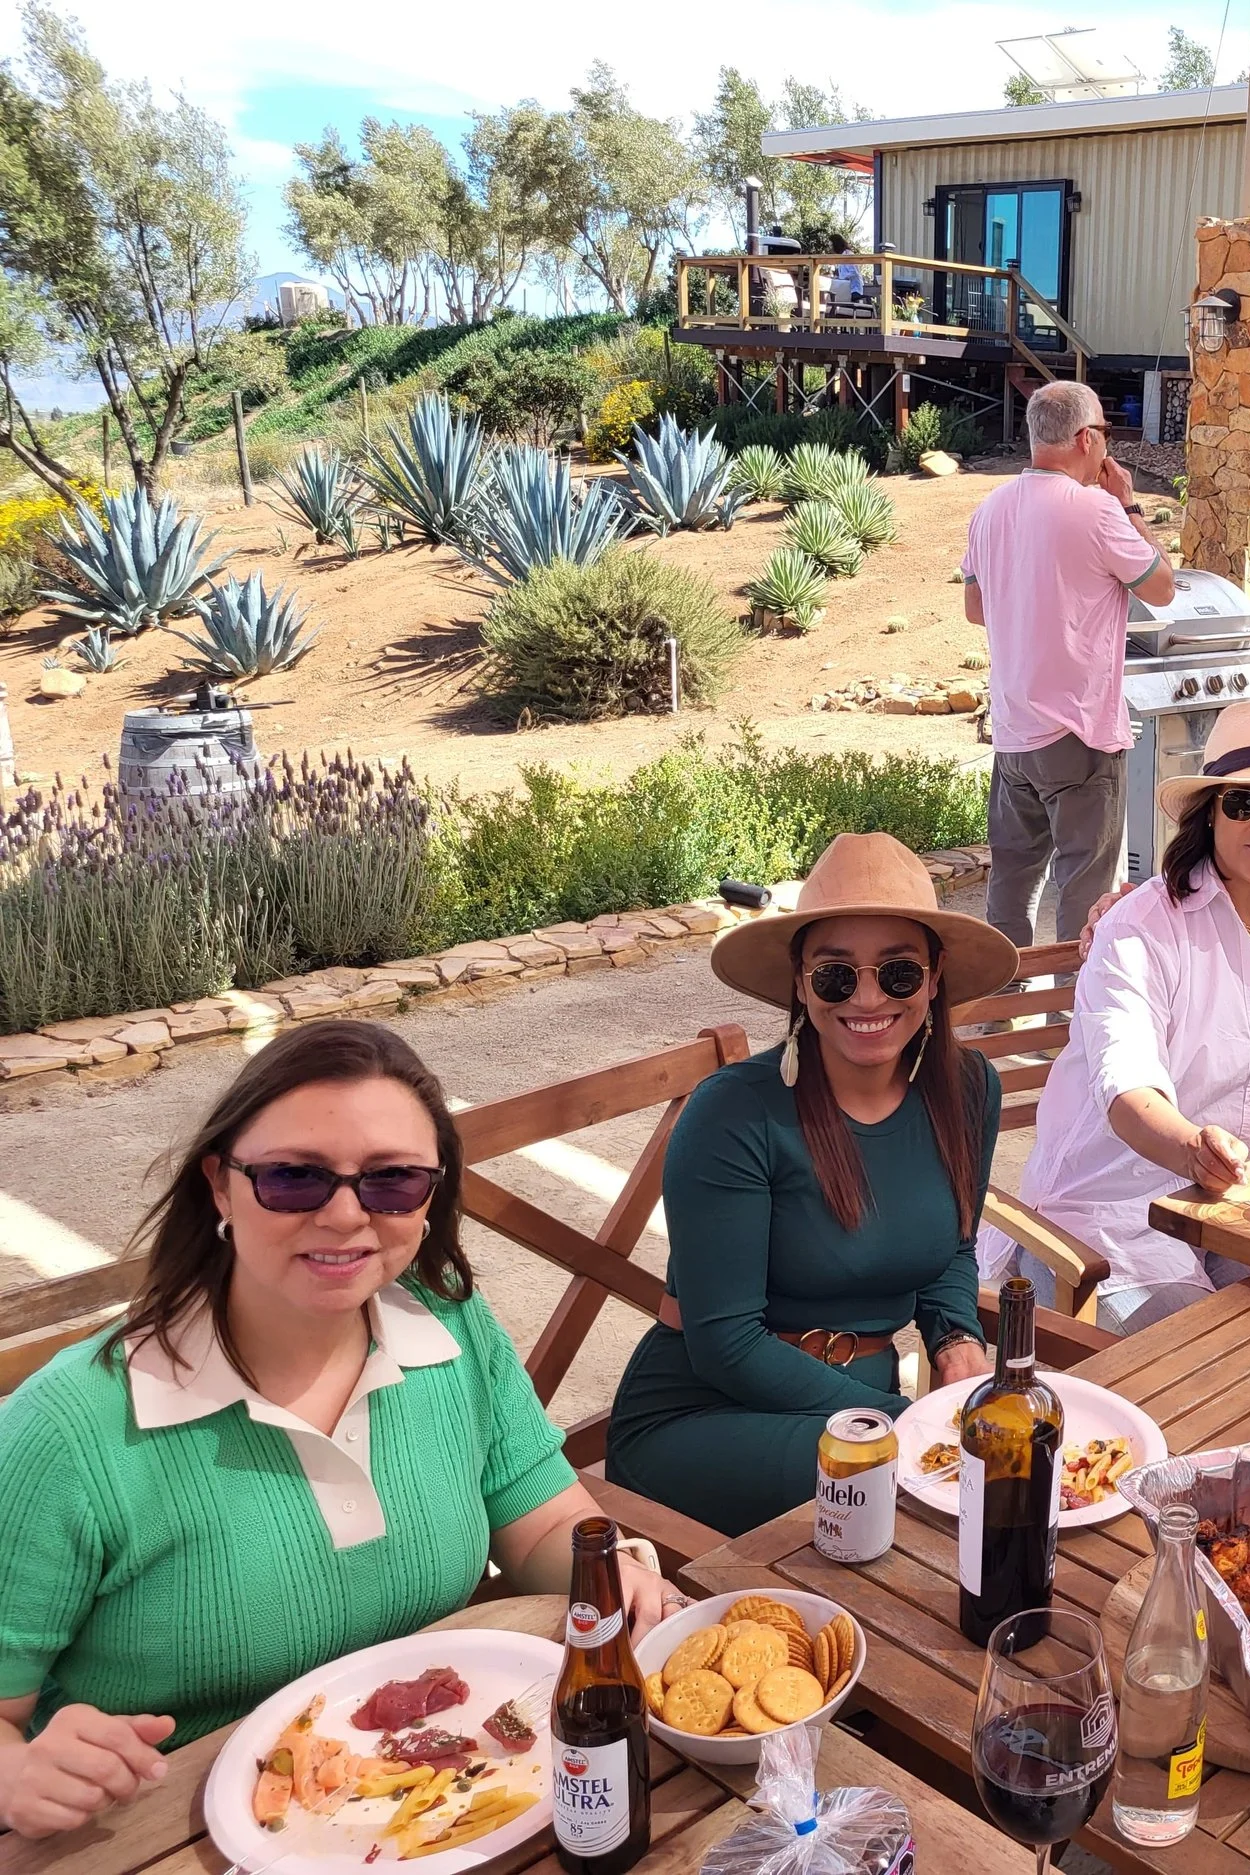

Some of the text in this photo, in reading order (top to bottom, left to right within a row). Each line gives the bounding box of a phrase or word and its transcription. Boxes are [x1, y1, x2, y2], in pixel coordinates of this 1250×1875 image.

[817, 1479, 866, 1507] odelo
[573, 1611, 597, 1621] AMSTEL
[564, 1755, 586, 1766] AMSTEL
[552, 1765, 613, 1795] AMSTEL
[553, 1778, 611, 1810] ULTRA
[570, 1822, 584, 1835] 85
